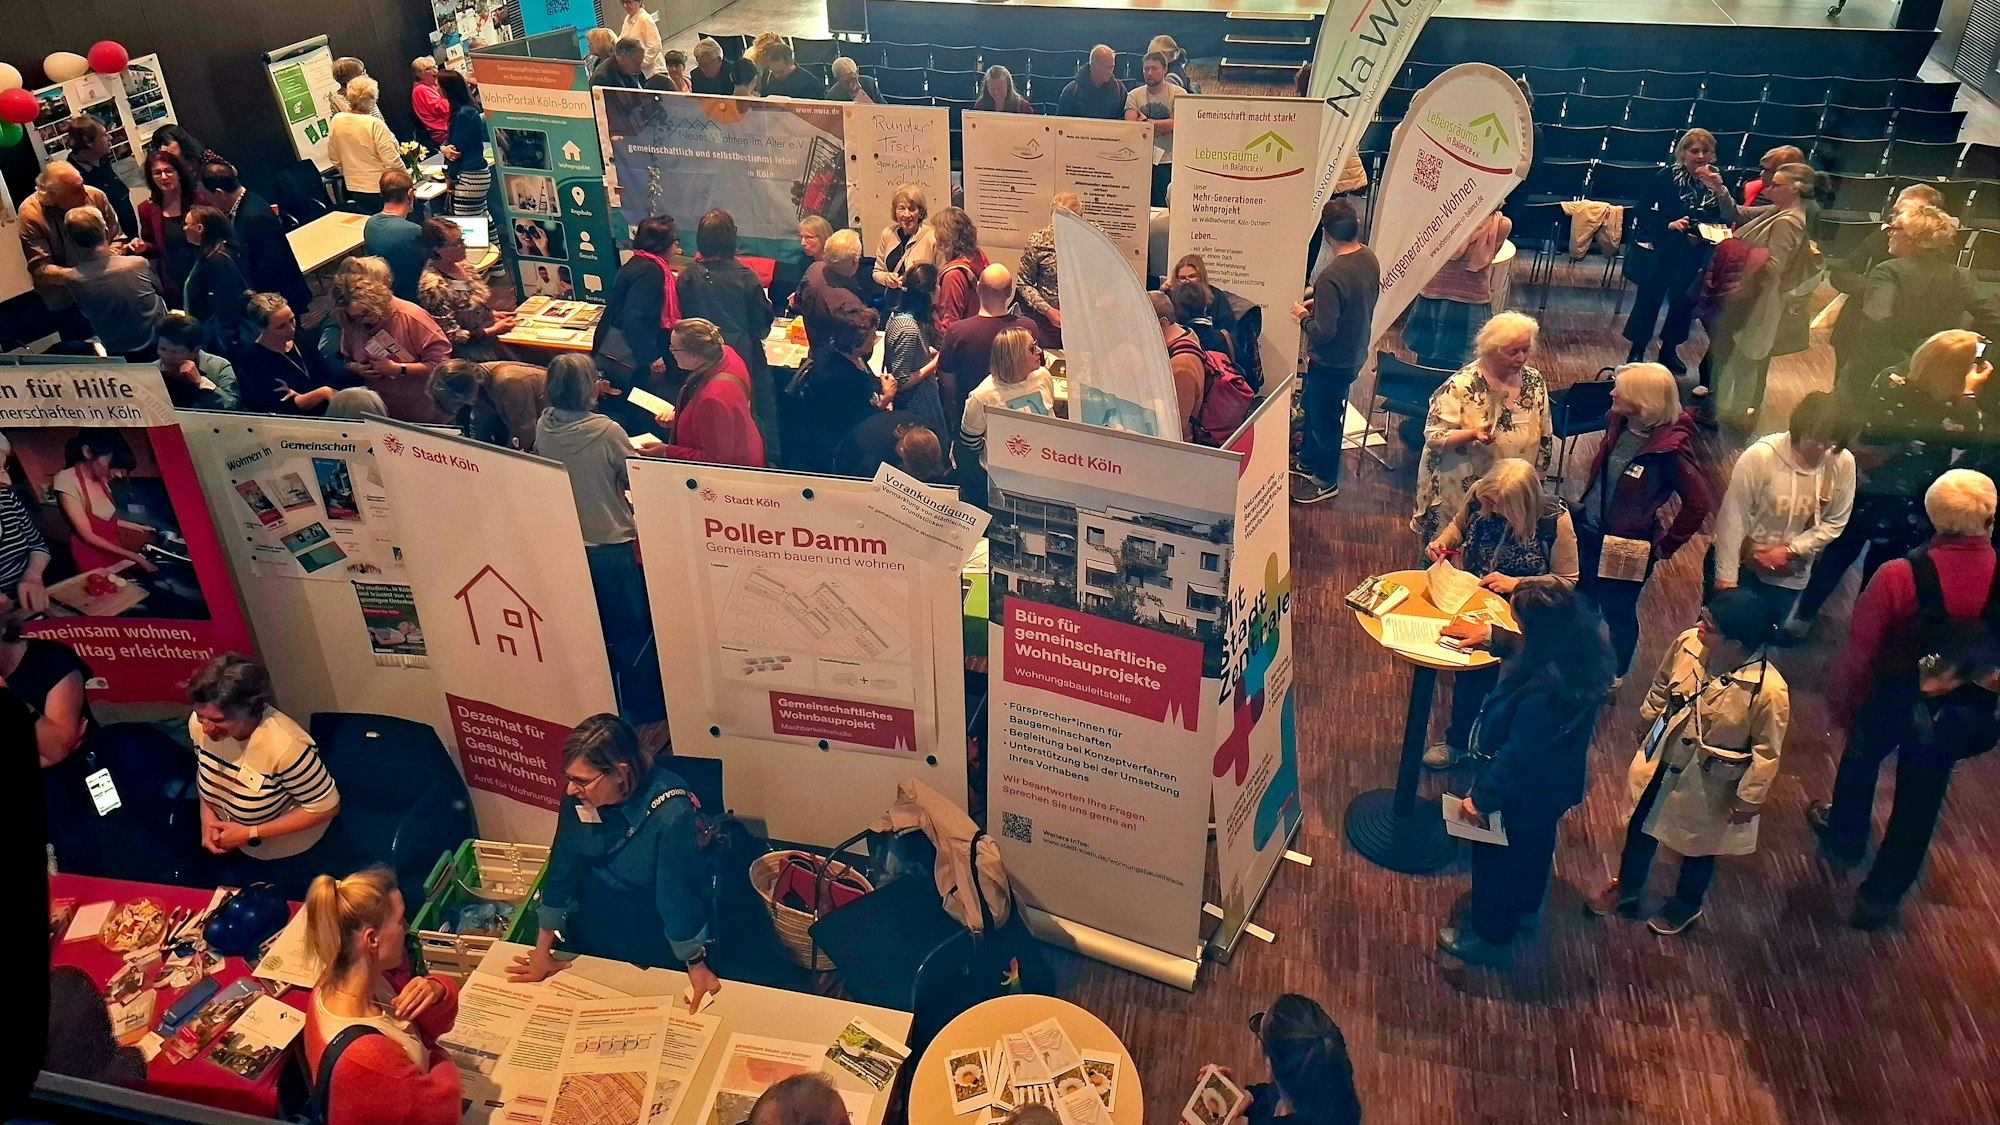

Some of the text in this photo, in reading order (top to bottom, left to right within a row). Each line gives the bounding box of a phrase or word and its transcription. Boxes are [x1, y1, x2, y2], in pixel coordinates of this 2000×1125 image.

[481, 91, 588, 110] WohnPortal Köln-Bonn
[795, 107, 840, 115] www.nwia.de
[1197, 109, 1296, 122] Gemeinschaft macht stark!
[1427, 108, 1479, 145] Lebensräume
[679, 131, 708, 141] Neues
[752, 137, 763, 147] im
[766, 137, 786, 148] Alter
[878, 135, 920, 153] Tisch
[1445, 133, 1452, 143] in
[1451, 136, 1473, 155] Balance
[628, 143, 797, 166] gemeinschaftlich und selbstbestimmt leben
[1195, 148, 1259, 162] Lebensräume
[756, 169, 774, 178] Köln
[1230, 163, 1254, 172] Balance
[1192, 193, 1267, 205] Mehr-Generationen-
[1192, 204, 1240, 215] Wohnprojekt
[26, 378, 62, 398] für
[72, 377, 134, 398] Hilfe
[89, 406, 104, 419] in
[108, 406, 142, 420] Köln
[227, 446, 272, 472] Wohnen in
[280, 440, 356, 453] Gemeinschaft
[412, 446, 480, 473] Stadt Köln
[1040, 447, 1123, 476] Stadt Köln
[724, 494, 781, 509] Stadt Köln
[882, 485, 921, 511] Vermarktung
[921, 507, 936, 517] von
[885, 473, 977, 525] Vorankündigung
[900, 504, 944, 528] Grundstücken
[704, 517, 888, 555] Poller Damm
[705, 541, 906, 572] Gemeinsam bauen und wohnen
[122, 624, 197, 643] wohnen,
[1015, 608, 1082, 635] Büro für
[73, 642, 116, 661] lltag
[1014, 626, 1168, 674] gemeinschaftliche
[1219, 591, 1291, 706] Zentrale
[1014, 642, 1161, 691] Wohnbauprojekte
[1014, 666, 1132, 705] Wohnungsbauleitstelle
[777, 697, 894, 722] Gemeinschaftliches
[779, 709, 876, 730] Wohnbauprojekt
[457, 705, 546, 740] Dezernat für
[1009, 715, 1112, 749] Baugemeinschaften
[1107, 728, 1123, 739] für
[461, 721, 524, 750] Soziales,
[465, 737, 548, 770] Gesundheit
[1009, 728, 1177, 782] Begleitung bei Konzeptverfahren
[469, 753, 557, 788] und Wohnen
[1008, 753, 1089, 783] Ihres Vorhabens
[1009, 741, 1180, 798] Unterstützung bei der Umsetzung
[474, 773, 494, 785] Amt
[495, 778, 508, 789] für
[1002, 773, 1148, 823] Wir beantworten Ihre Fragen.
[1002, 785, 1137, 832] Sprechen Sie uns gerne an!
[1043, 829, 1069, 843] Weitere
